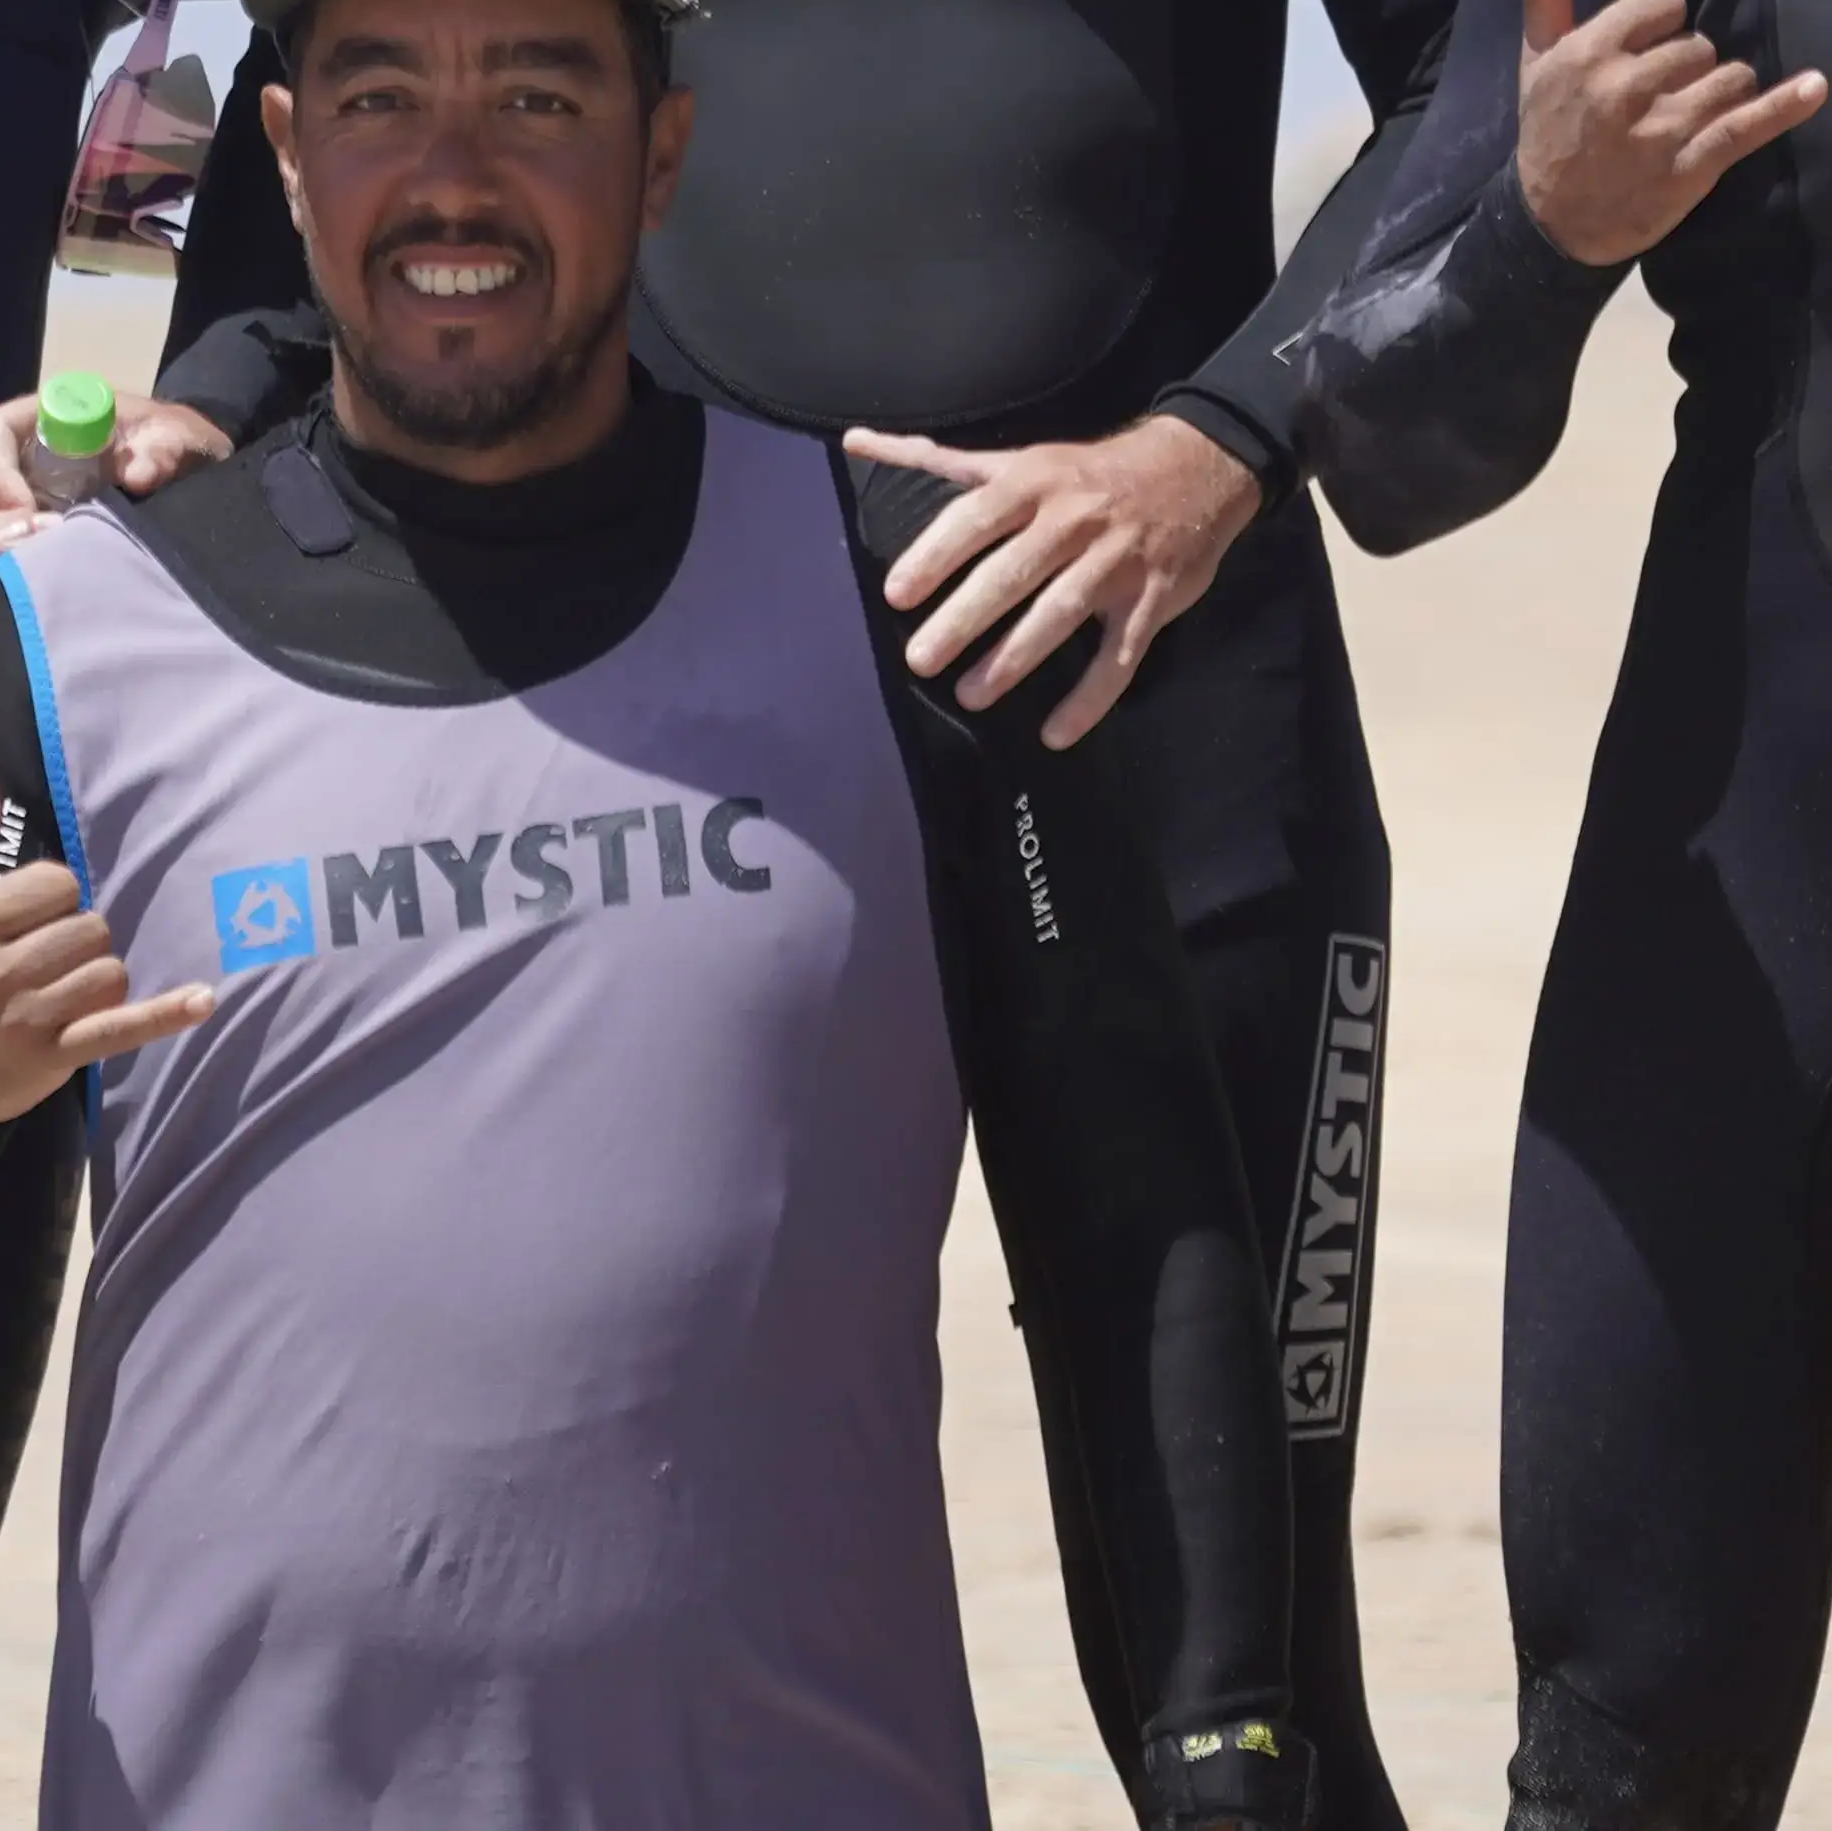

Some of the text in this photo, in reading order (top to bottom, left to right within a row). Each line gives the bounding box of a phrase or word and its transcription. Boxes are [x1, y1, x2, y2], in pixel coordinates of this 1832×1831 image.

[322, 796, 772, 949] MYSTIC
[1014, 792, 1060, 943] PROLIMIT
[1288, 953, 1381, 1332] MYSTIC
